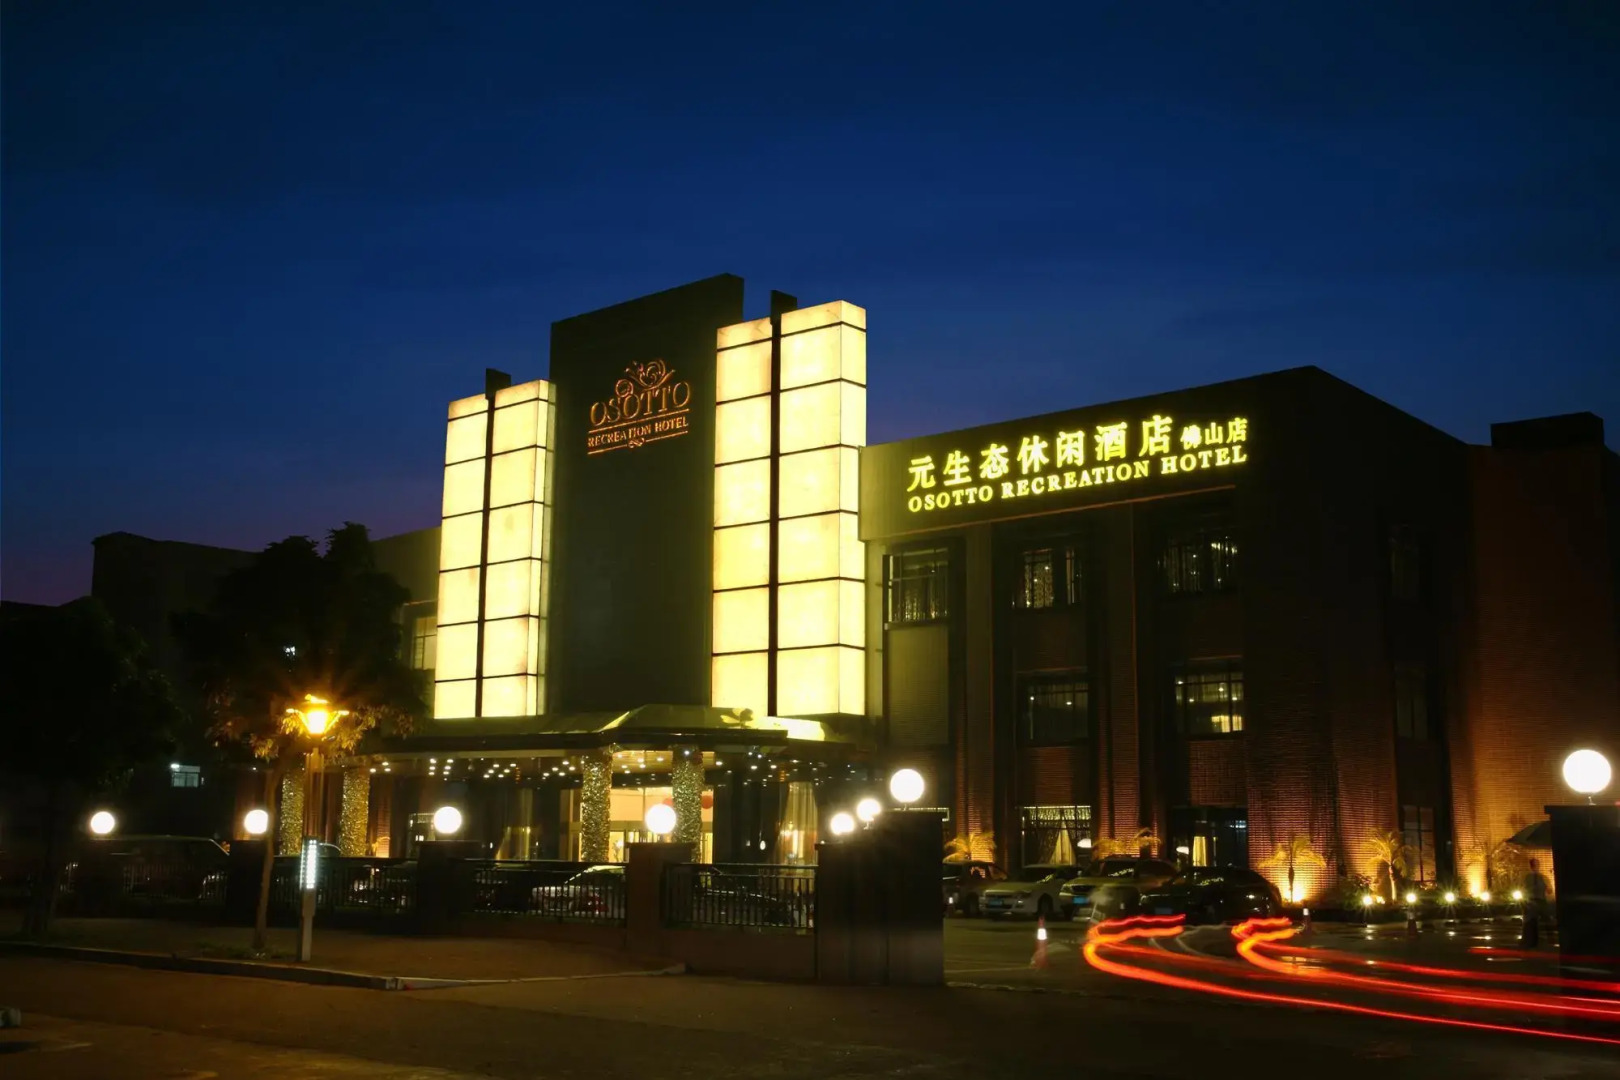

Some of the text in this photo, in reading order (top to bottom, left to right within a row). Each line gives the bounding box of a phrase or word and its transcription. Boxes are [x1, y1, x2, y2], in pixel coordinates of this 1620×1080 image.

[590, 381, 690, 426] OSOTTO
[588, 417, 689, 447] RECREATION HOTEL
[906, 414, 1172, 491] 元生态休闲酒店
[907, 445, 1247, 512] OSOTTO RECREATION HOTEL
